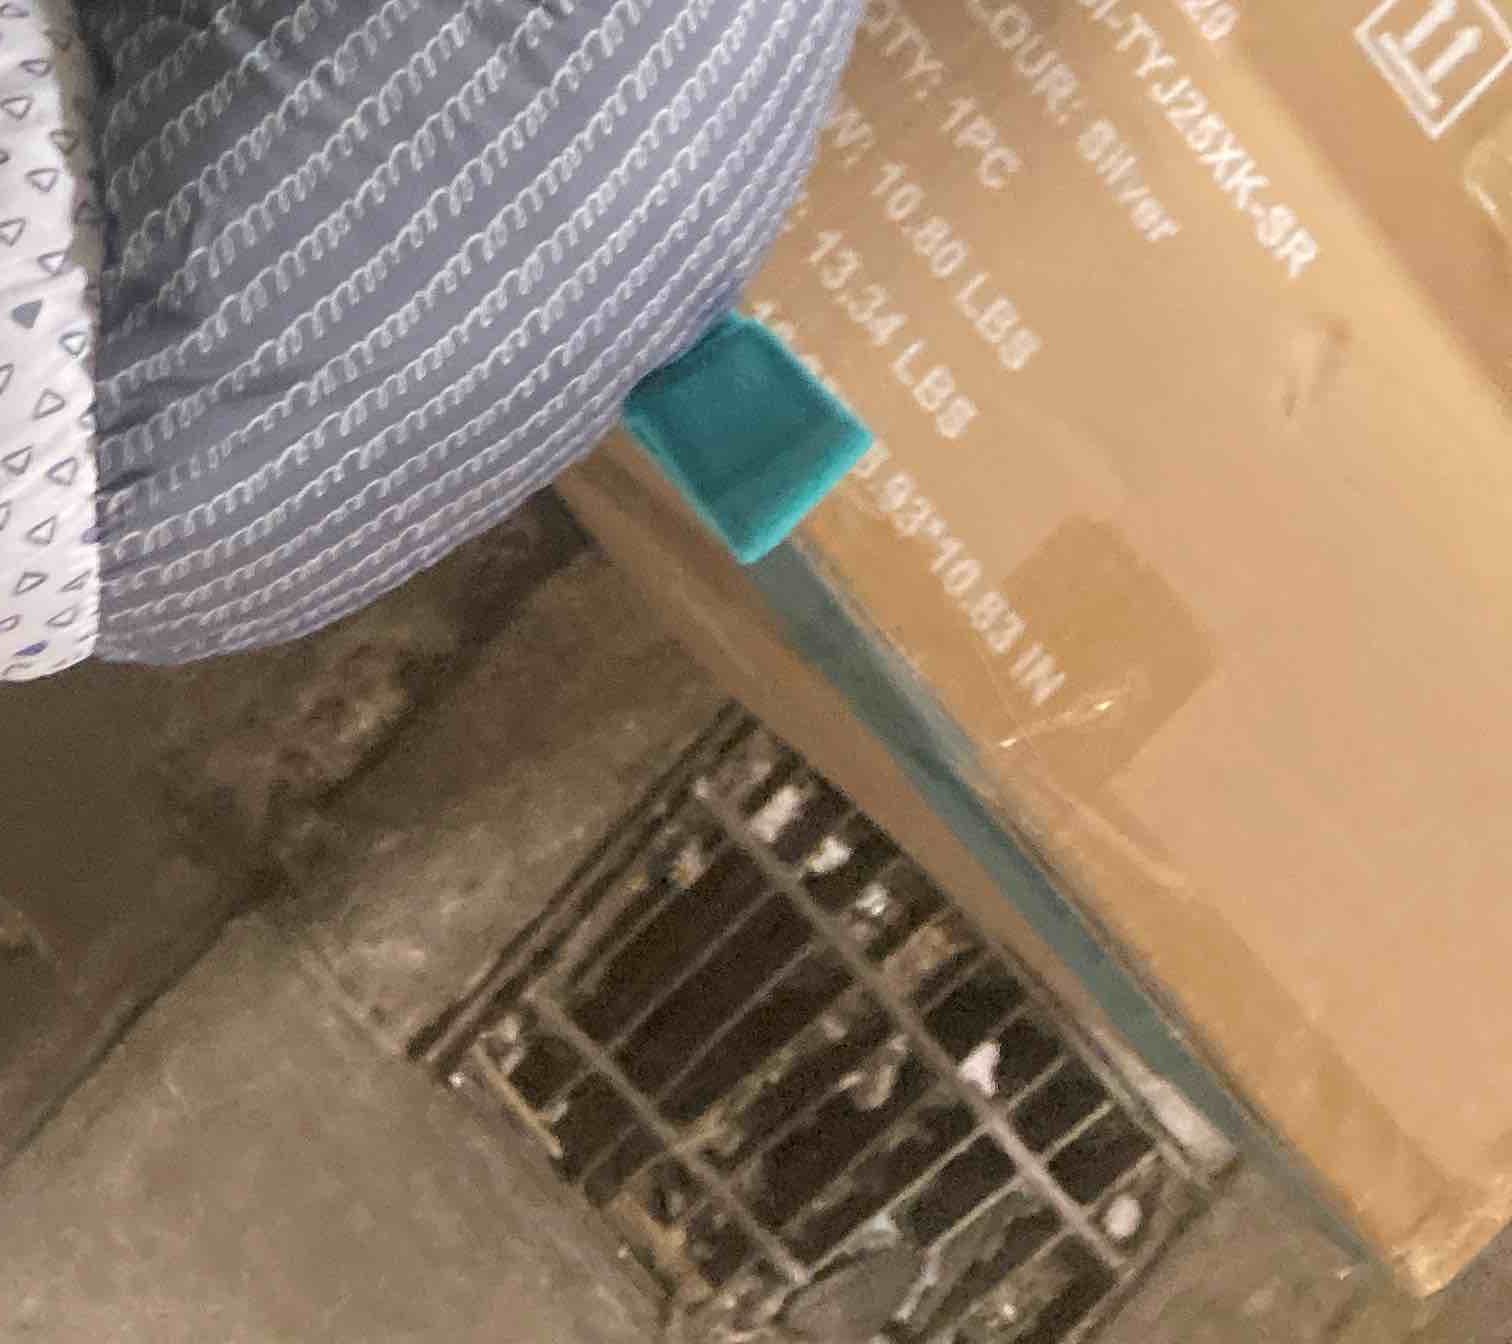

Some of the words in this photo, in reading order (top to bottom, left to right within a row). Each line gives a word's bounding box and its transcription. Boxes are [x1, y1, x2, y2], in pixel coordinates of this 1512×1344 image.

[940, 96, 1025, 191] 1PC
[1078, 118, 1182, 242] Silver
[953, 271, 1043, 372] LBS
[890, 337, 980, 440] LBS
[1009, 641, 1068, 707] IN
